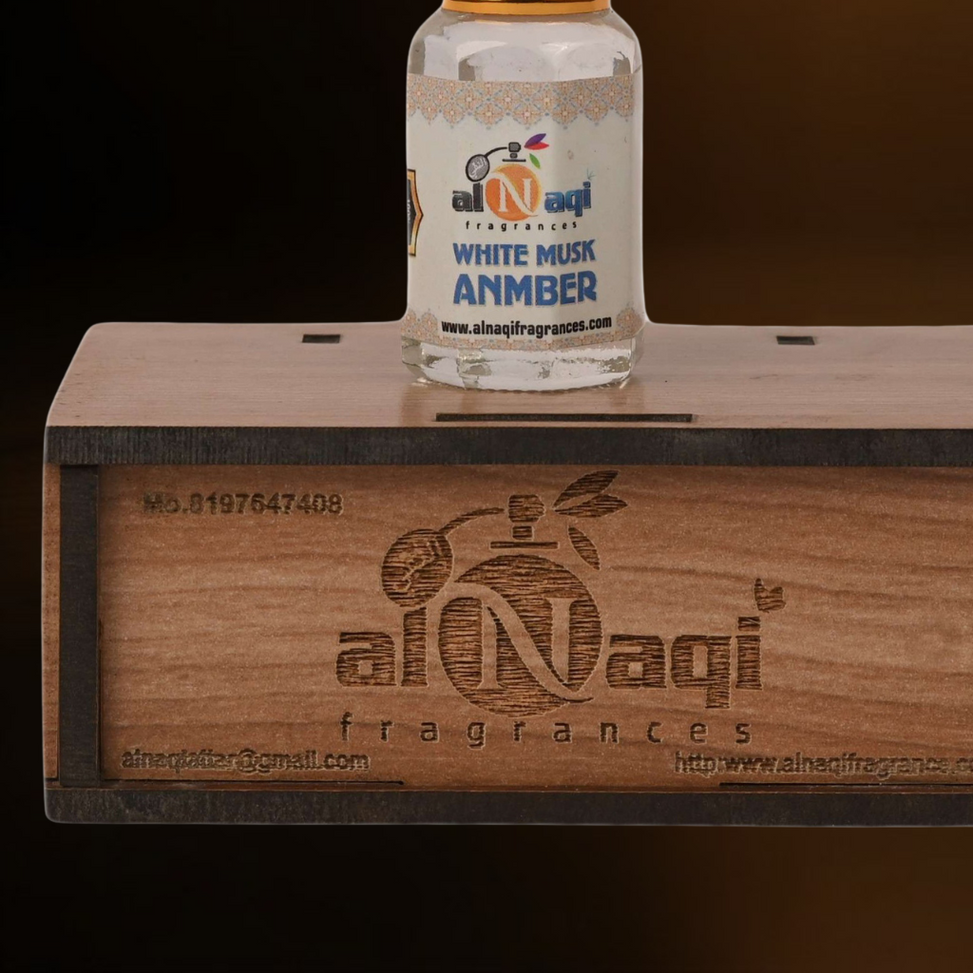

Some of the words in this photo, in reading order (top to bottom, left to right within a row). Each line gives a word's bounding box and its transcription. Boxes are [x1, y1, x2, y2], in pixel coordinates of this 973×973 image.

[452, 173, 592, 218] alNaqi
[465, 220, 578, 232] fragrances
[452, 242, 529, 266] WHITE
[536, 239, 597, 266] MUSK
[452, 270, 598, 307] ANMBER
[441, 316, 613, 339] www.alnaqifragrances.com
[336, 584, 763, 709] alNaqi
[340, 712, 752, 750] fragrances
